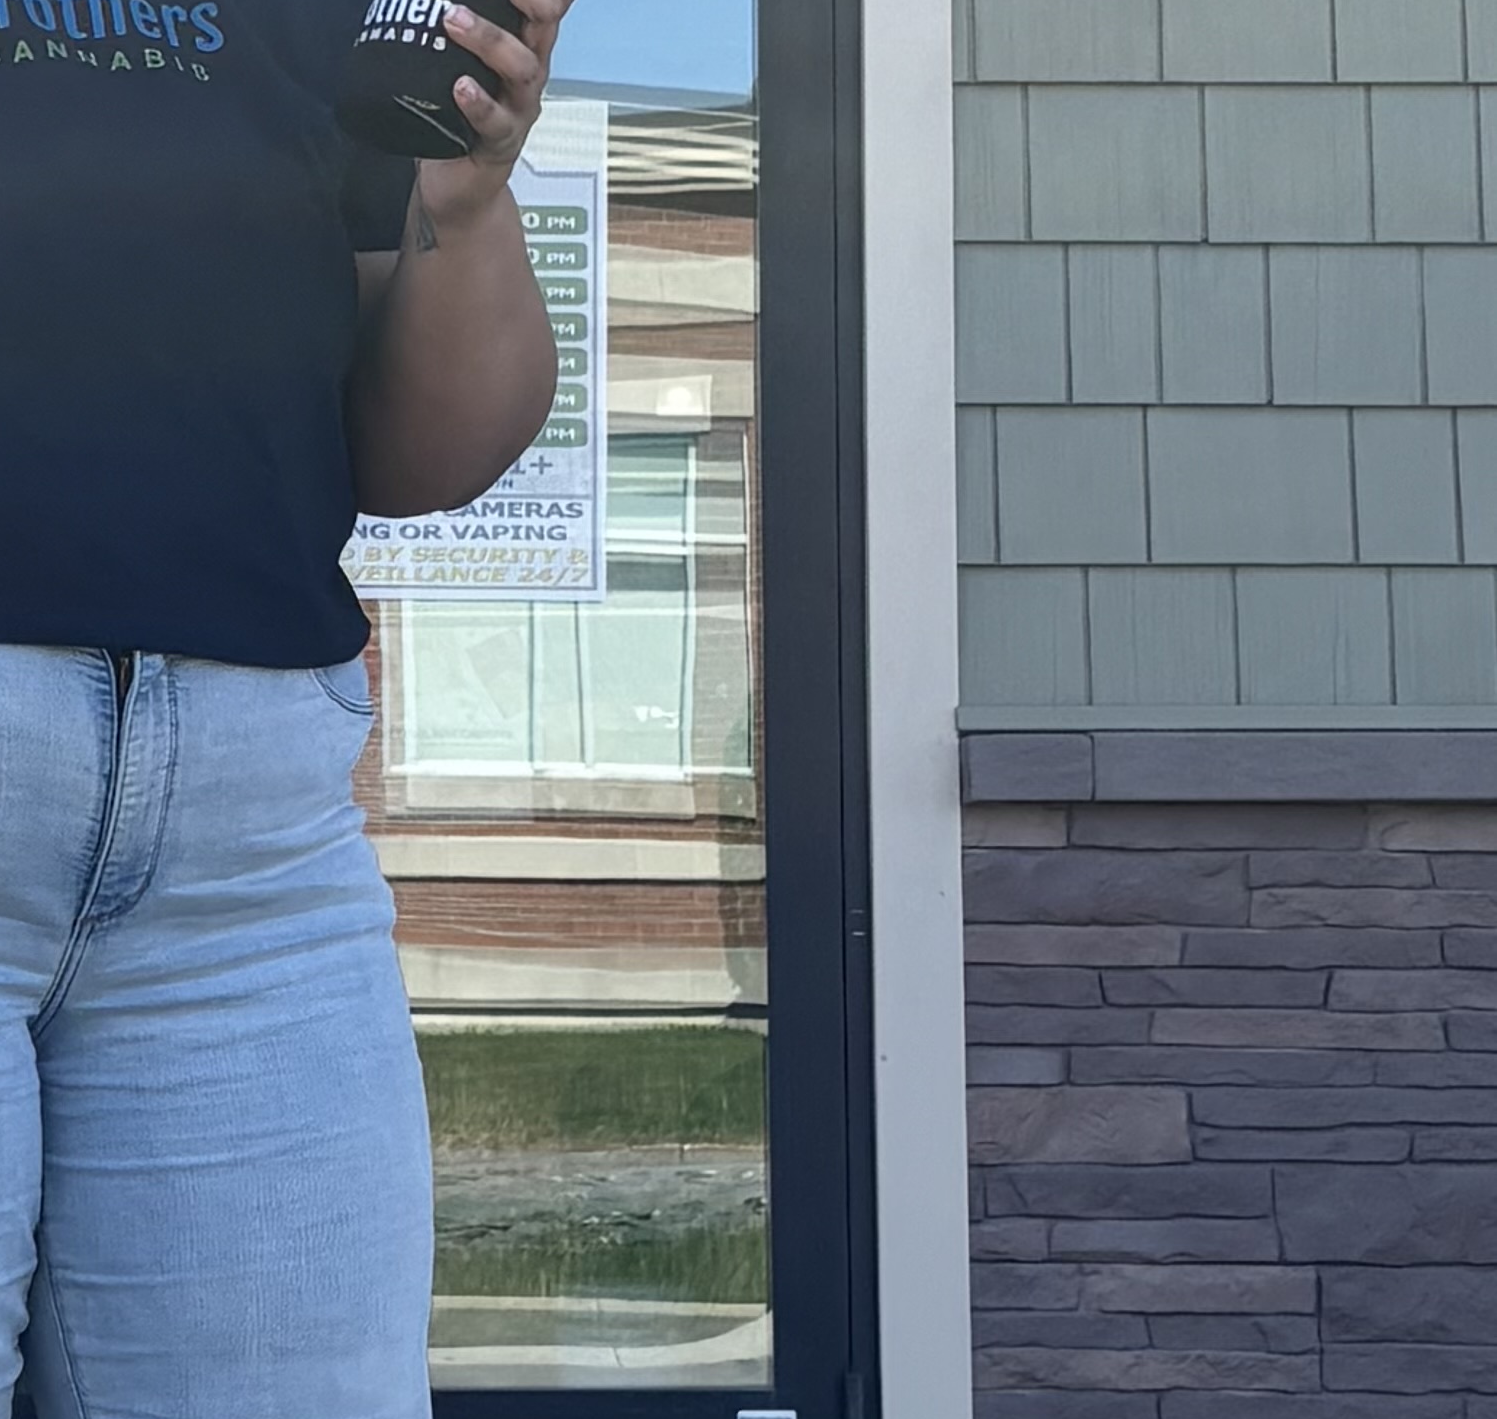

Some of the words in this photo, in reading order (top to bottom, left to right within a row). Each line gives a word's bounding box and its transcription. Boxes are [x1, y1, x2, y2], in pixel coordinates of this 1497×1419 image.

[547, 216, 575, 230] PM
[547, 252, 575, 264] PM
[546, 287, 575, 299] PM
[546, 427, 575, 441] PM
[355, 524, 391, 540] NG
[399, 524, 442, 540] OR
[450, 524, 567, 541] VAPING
[364, 546, 404, 563] BY
[410, 547, 562, 564] SECURITY
[344, 566, 508, 583] VEILLANCE
[517, 567, 589, 586] 24/7
